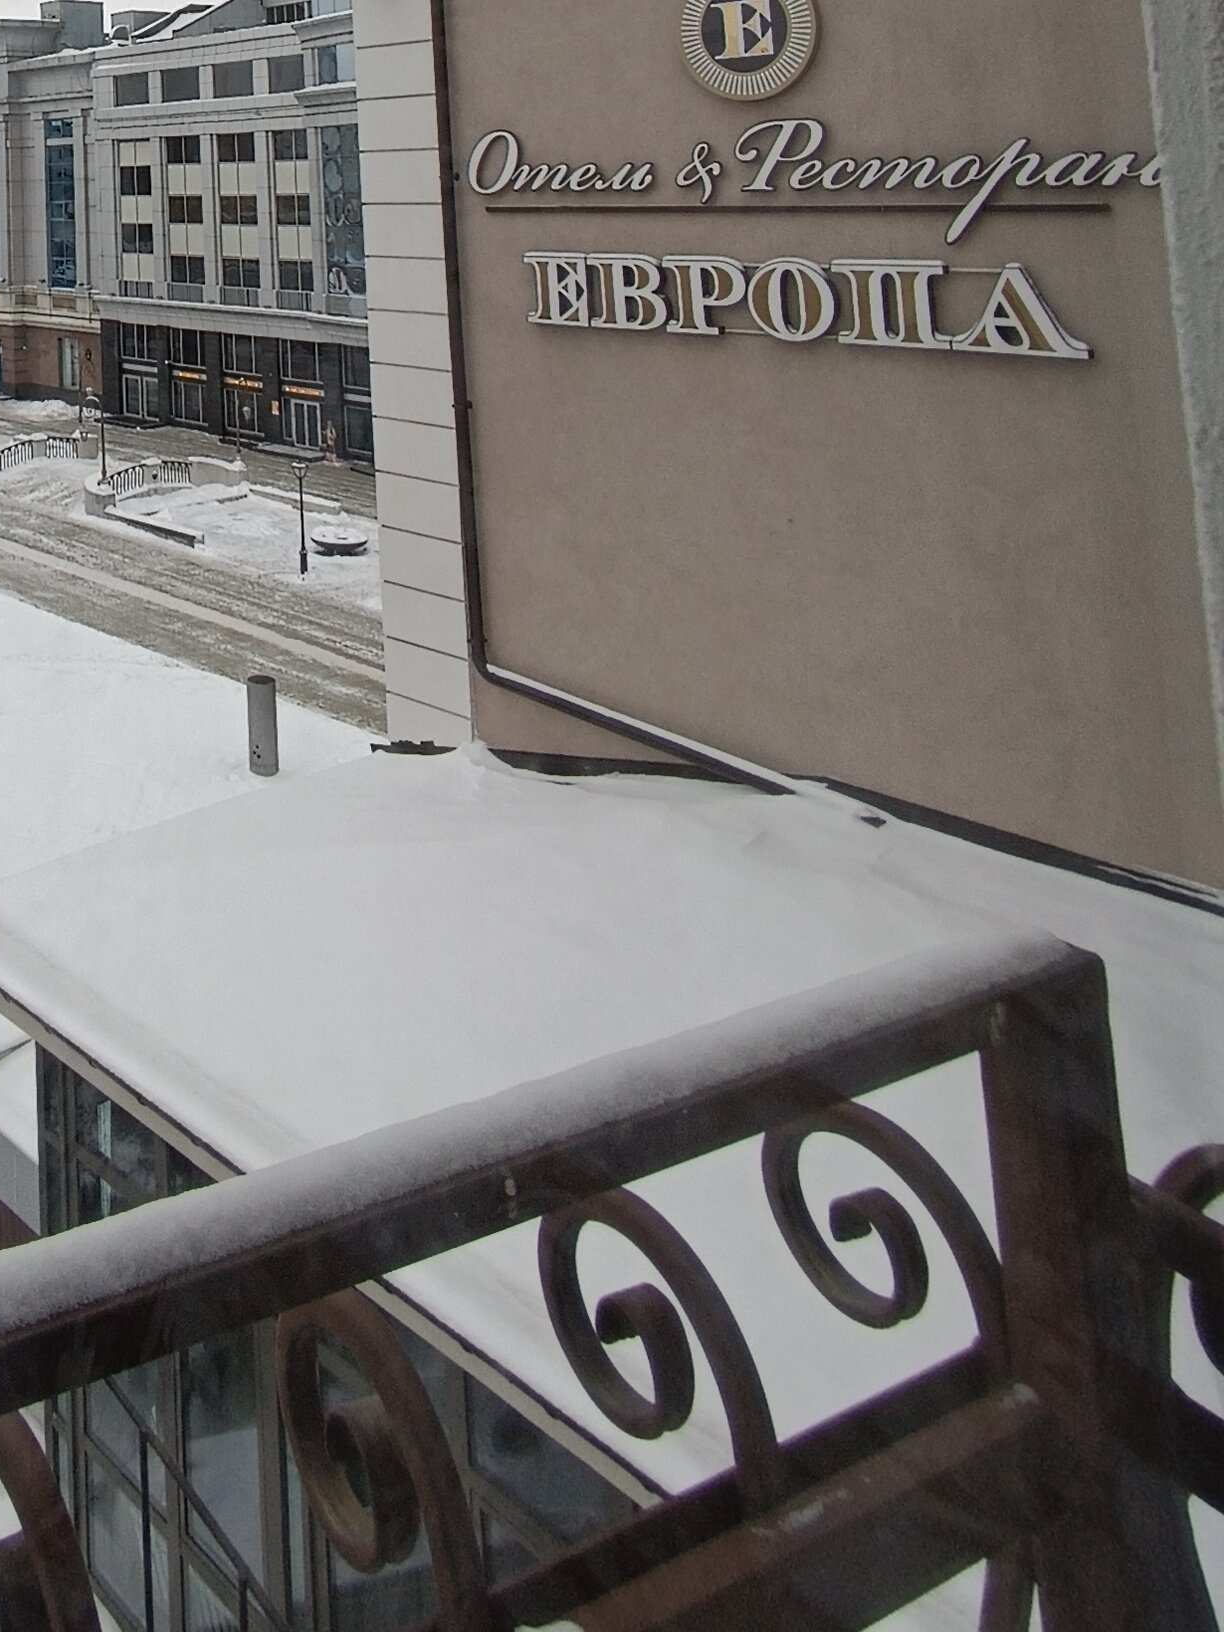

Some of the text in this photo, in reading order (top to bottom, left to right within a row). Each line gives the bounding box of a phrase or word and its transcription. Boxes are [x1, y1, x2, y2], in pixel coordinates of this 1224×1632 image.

[468, 130, 654, 195] Отель
[675, 142, 722, 204] &
[522, 251, 1094, 360] ЕВРОПА
